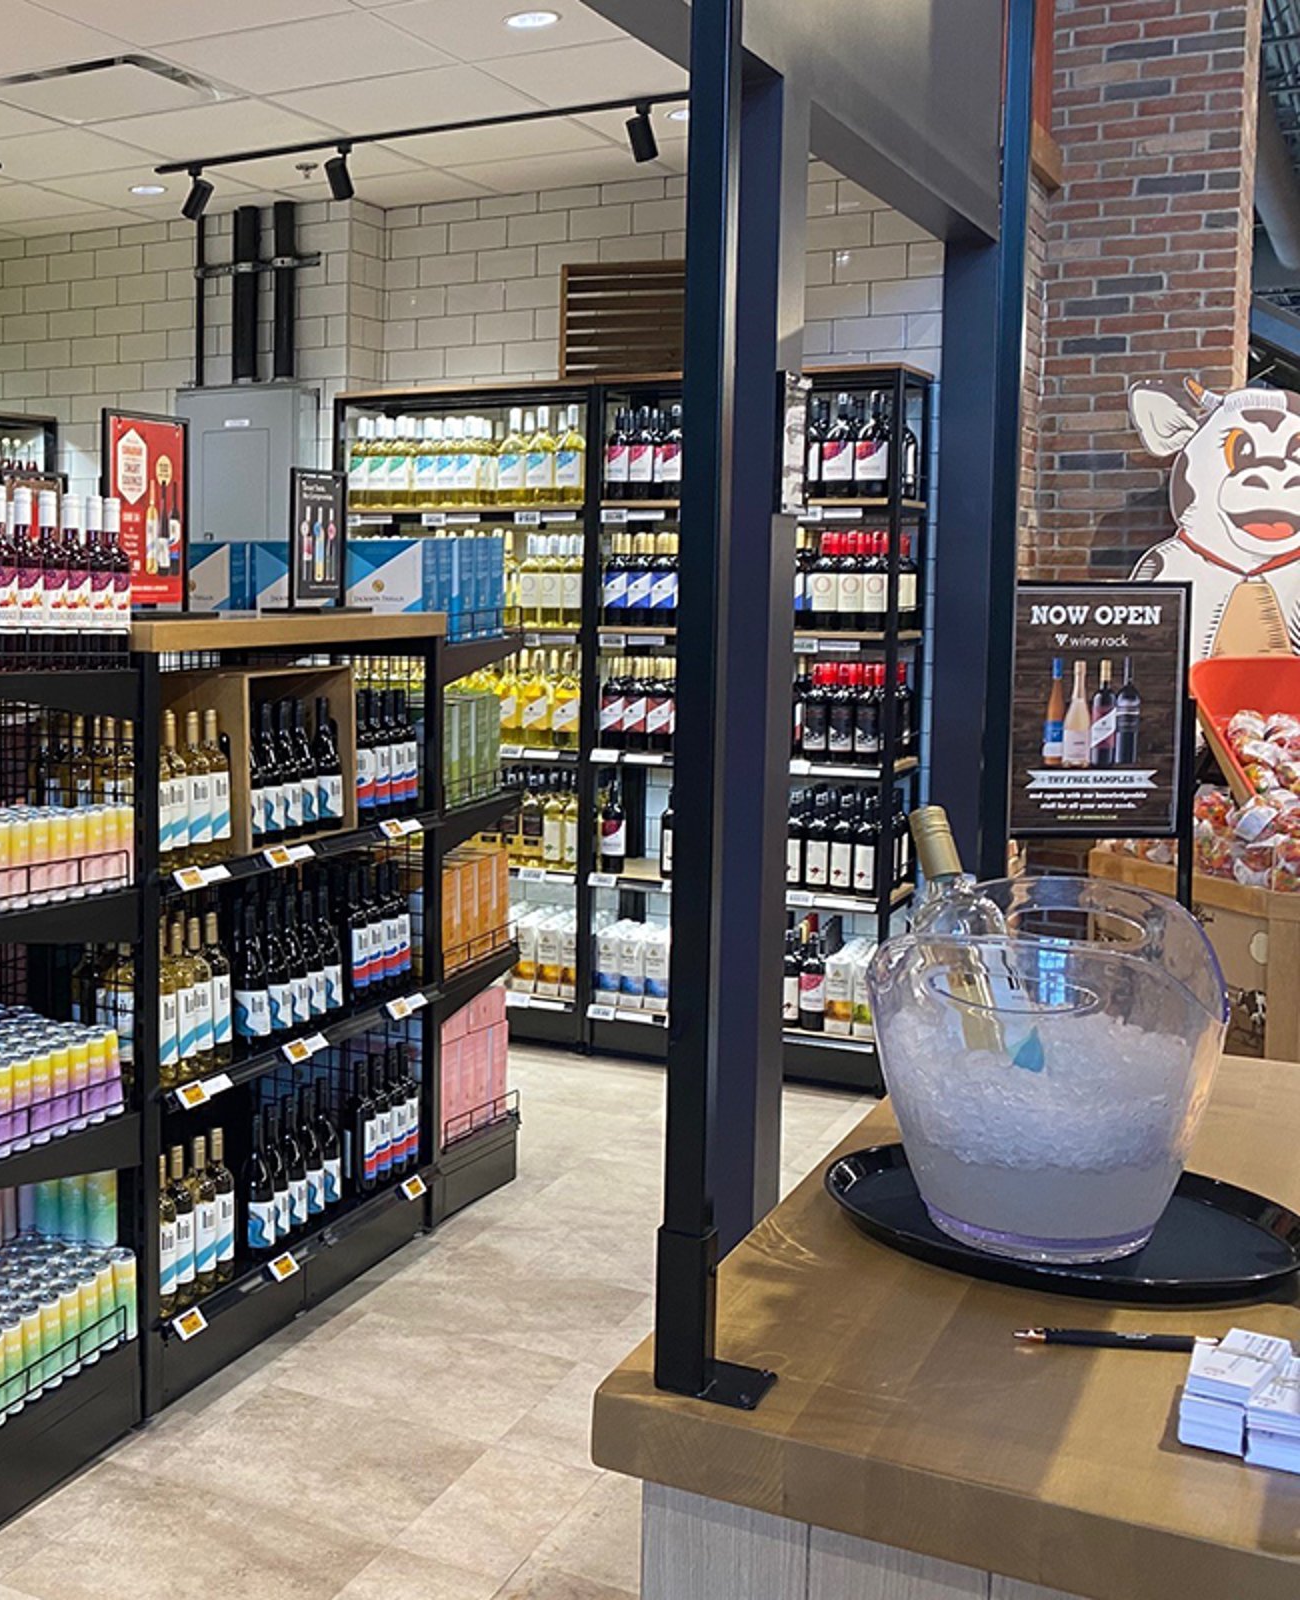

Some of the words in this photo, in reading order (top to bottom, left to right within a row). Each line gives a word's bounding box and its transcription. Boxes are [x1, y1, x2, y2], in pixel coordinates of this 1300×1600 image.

[1031, 605, 1090, 625] NOW
[1095, 605, 1162, 625] OPEN
[1071, 635, 1099, 647] wine
[1101, 634, 1129, 647] rack
[1048, 775, 1066, 784] TRY
[1066, 775, 1090, 784] FREE
[1092, 776, 1135, 784] SAMPLES
